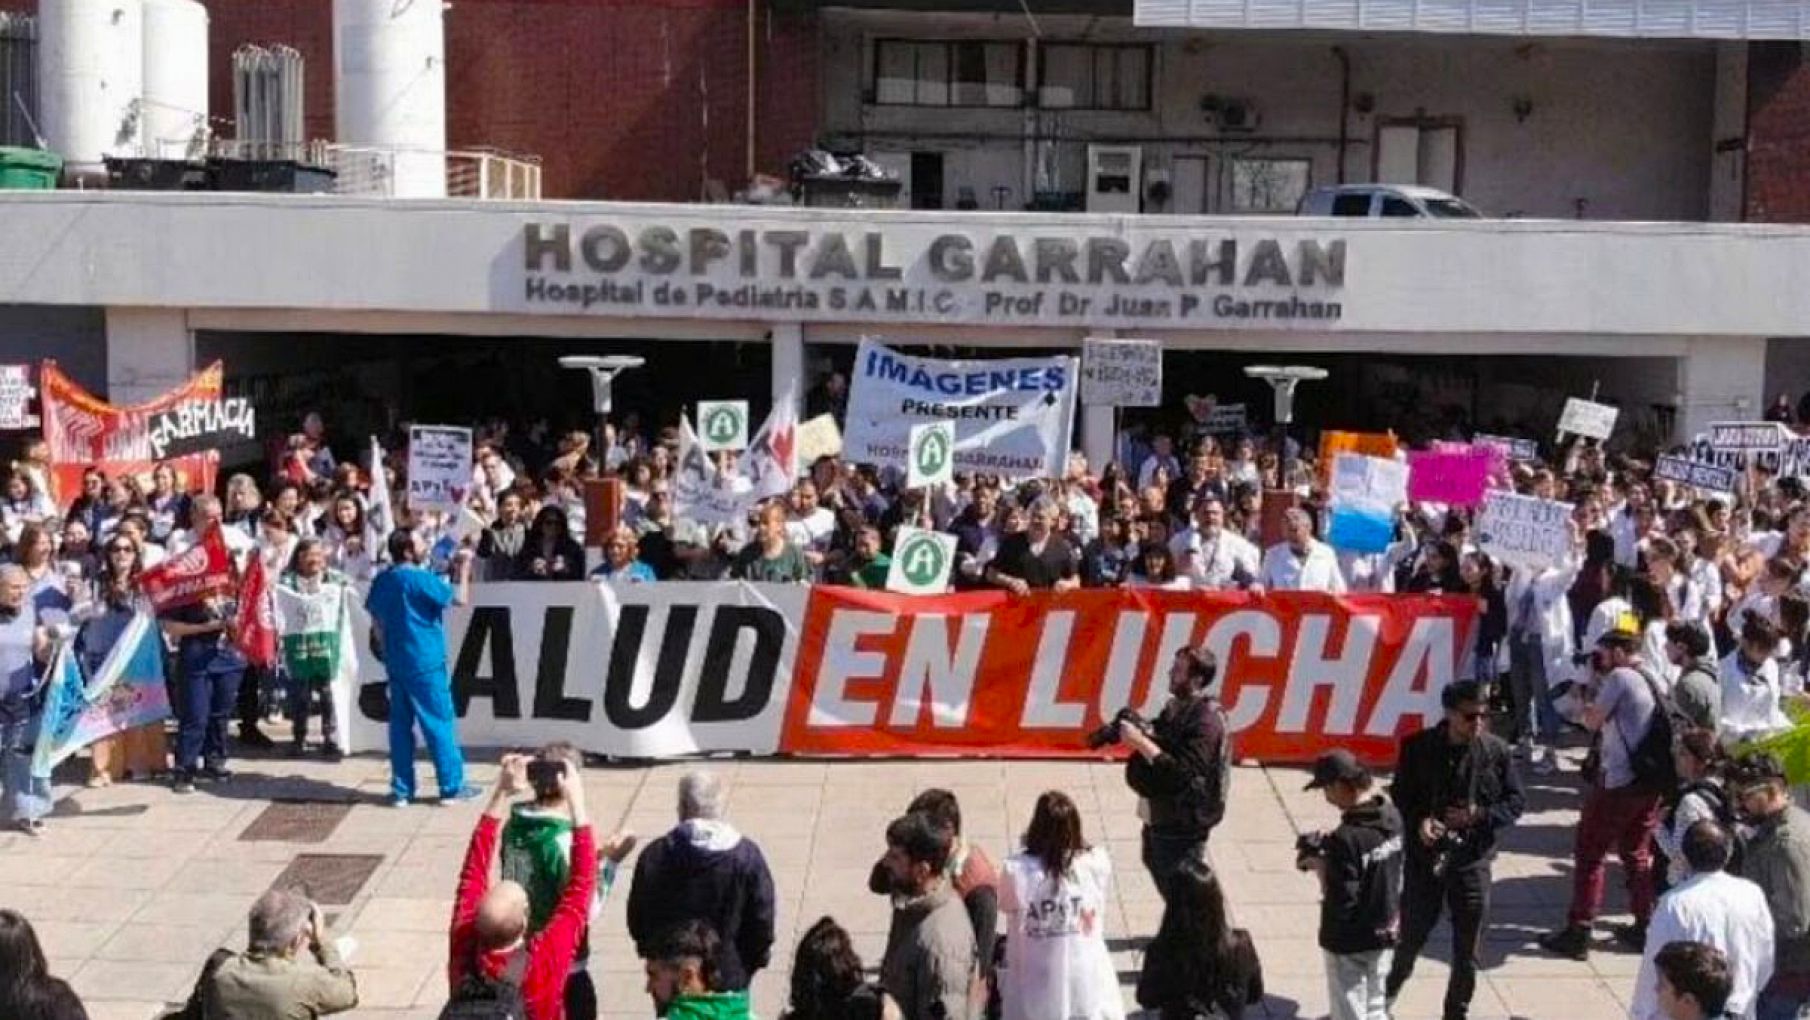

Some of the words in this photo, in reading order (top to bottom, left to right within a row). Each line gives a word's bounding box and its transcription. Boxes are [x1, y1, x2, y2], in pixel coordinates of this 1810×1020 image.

[525, 224, 902, 279] HOSPITAL
[929, 234, 1347, 287] GARRAHAN
[526, 278, 642, 309] Hospital
[652, 281, 686, 306] de
[1105, 294, 1171, 319] Juan
[1212, 294, 1342, 321] Garrahan
[865, 350, 1066, 396] IMÁGENES
[901, 398, 1019, 421] PRESENTE
[359, 603, 787, 730] ALUD
[806, 609, 990, 728] EN
[1019, 609, 1456, 735] LUCHA
